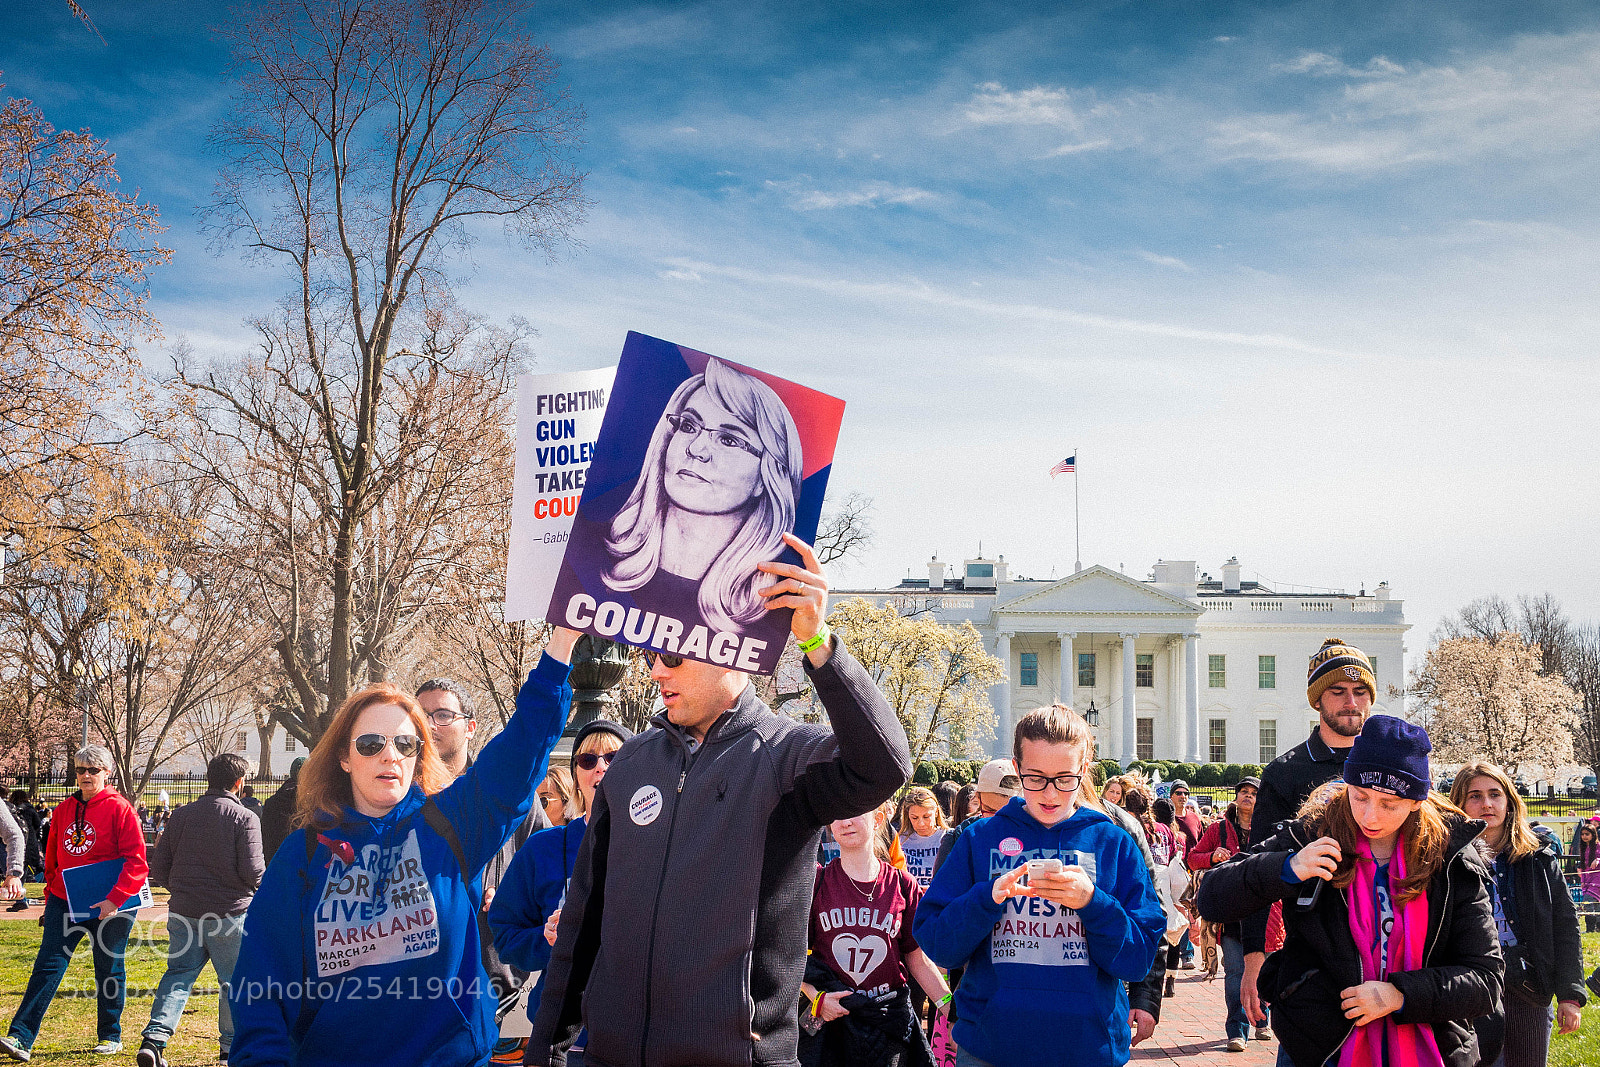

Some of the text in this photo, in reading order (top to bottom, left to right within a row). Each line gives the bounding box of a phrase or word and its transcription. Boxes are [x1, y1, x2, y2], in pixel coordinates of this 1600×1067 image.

[536, 388, 605, 416] FIGHTING
[536, 418, 575, 442] GUN
[533, 495, 582, 520] COU
[532, 530, 570, 545] —Gabb
[565, 593, 768, 672] COURAGE
[631, 791, 657, 809] COURAGE
[64, 838, 93, 854] CAJUNS
[991, 852, 1079, 871] MAH
[323, 873, 370, 901] FOR
[316, 899, 388, 923] LIVES
[1002, 896, 1056, 917] IVES
[317, 908, 435, 947] PARKLAND
[819, 907, 902, 939] DOUGLAS
[402, 928, 438, 945] NEVER
[404, 938, 439, 954] AGAIN
[993, 939, 1040, 950] MARCH 24
[1062, 941, 1087, 951] NEVE
[318, 943, 377, 961] MARCH 24
[847, 947, 875, 974] 17
[993, 949, 1016, 958] 2018
[319, 959, 351, 971] 2018
